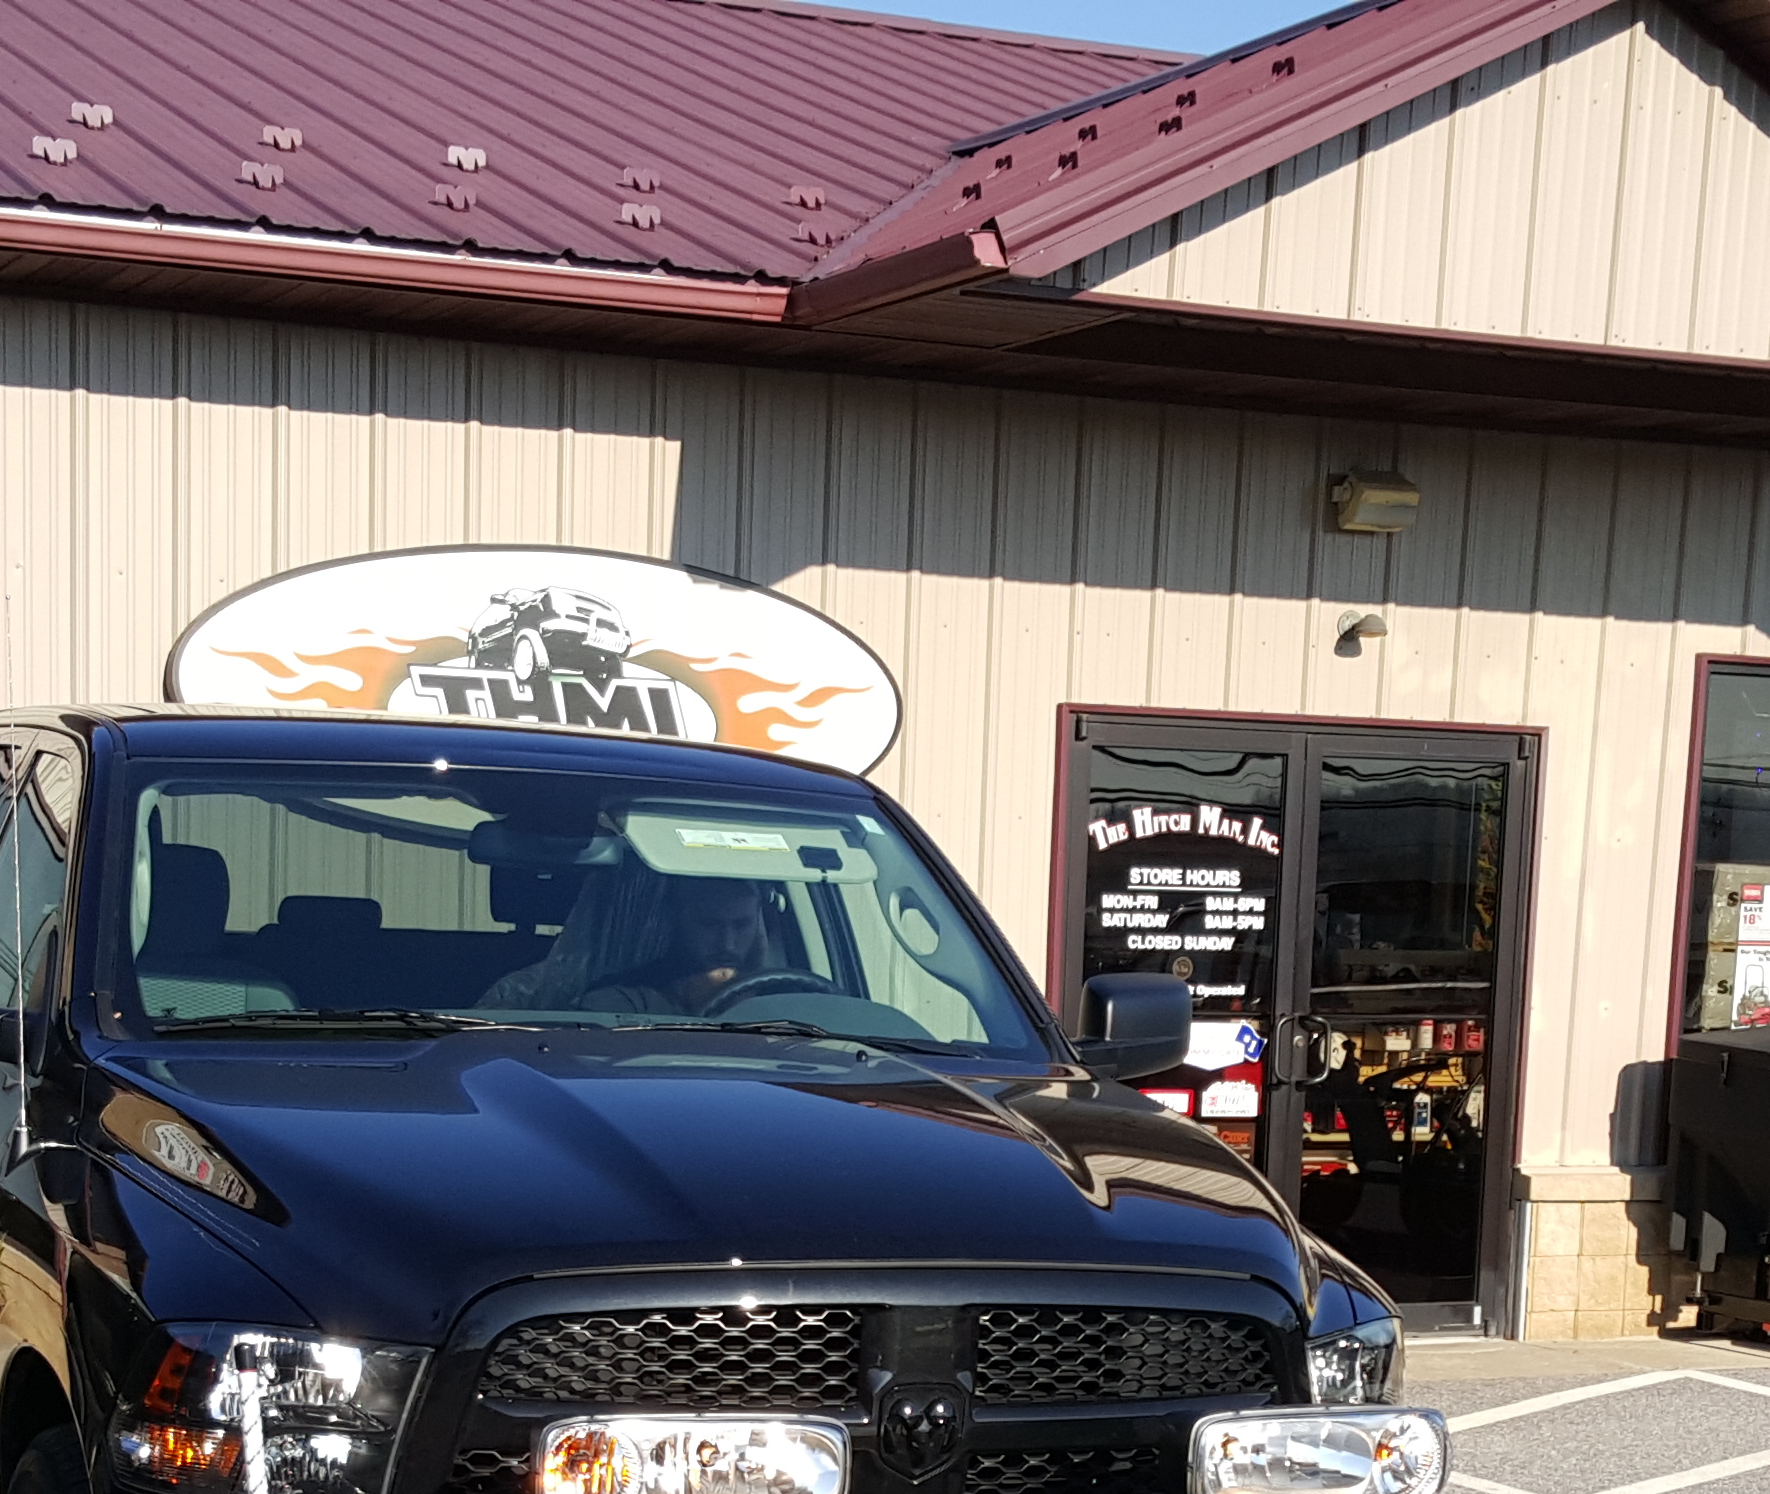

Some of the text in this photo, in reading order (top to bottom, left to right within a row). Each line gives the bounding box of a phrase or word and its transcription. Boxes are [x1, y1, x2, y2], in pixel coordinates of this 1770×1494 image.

[409, 664, 687, 738] THMI
[1132, 806, 1192, 839] HITCH
[1130, 867, 1240, 887] STORE HOURS
[1102, 894, 1265, 912] MON-FRI 9AM-6PM
[1102, 913, 1265, 930] SATURDAY 9AM-5PM
[1128, 935, 1235, 951] CLOSED SUNDAY
